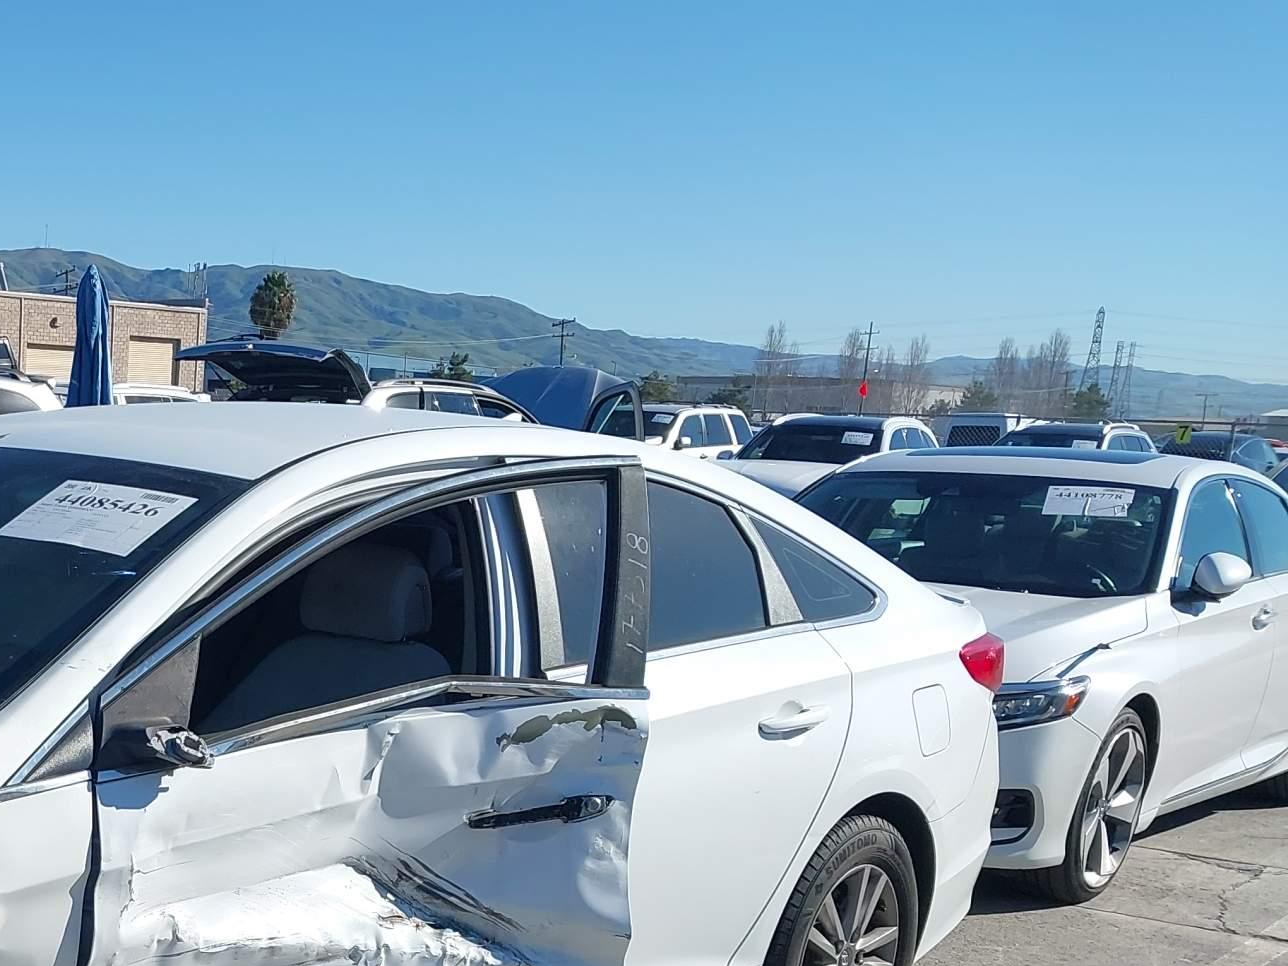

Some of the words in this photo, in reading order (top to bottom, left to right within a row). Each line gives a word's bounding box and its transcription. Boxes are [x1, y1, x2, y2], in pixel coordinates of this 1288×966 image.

[1178, 425, 1190, 441] 7
[54, 493, 162, 518] 44085426
[825, 833, 878, 880] SUMITOMO
